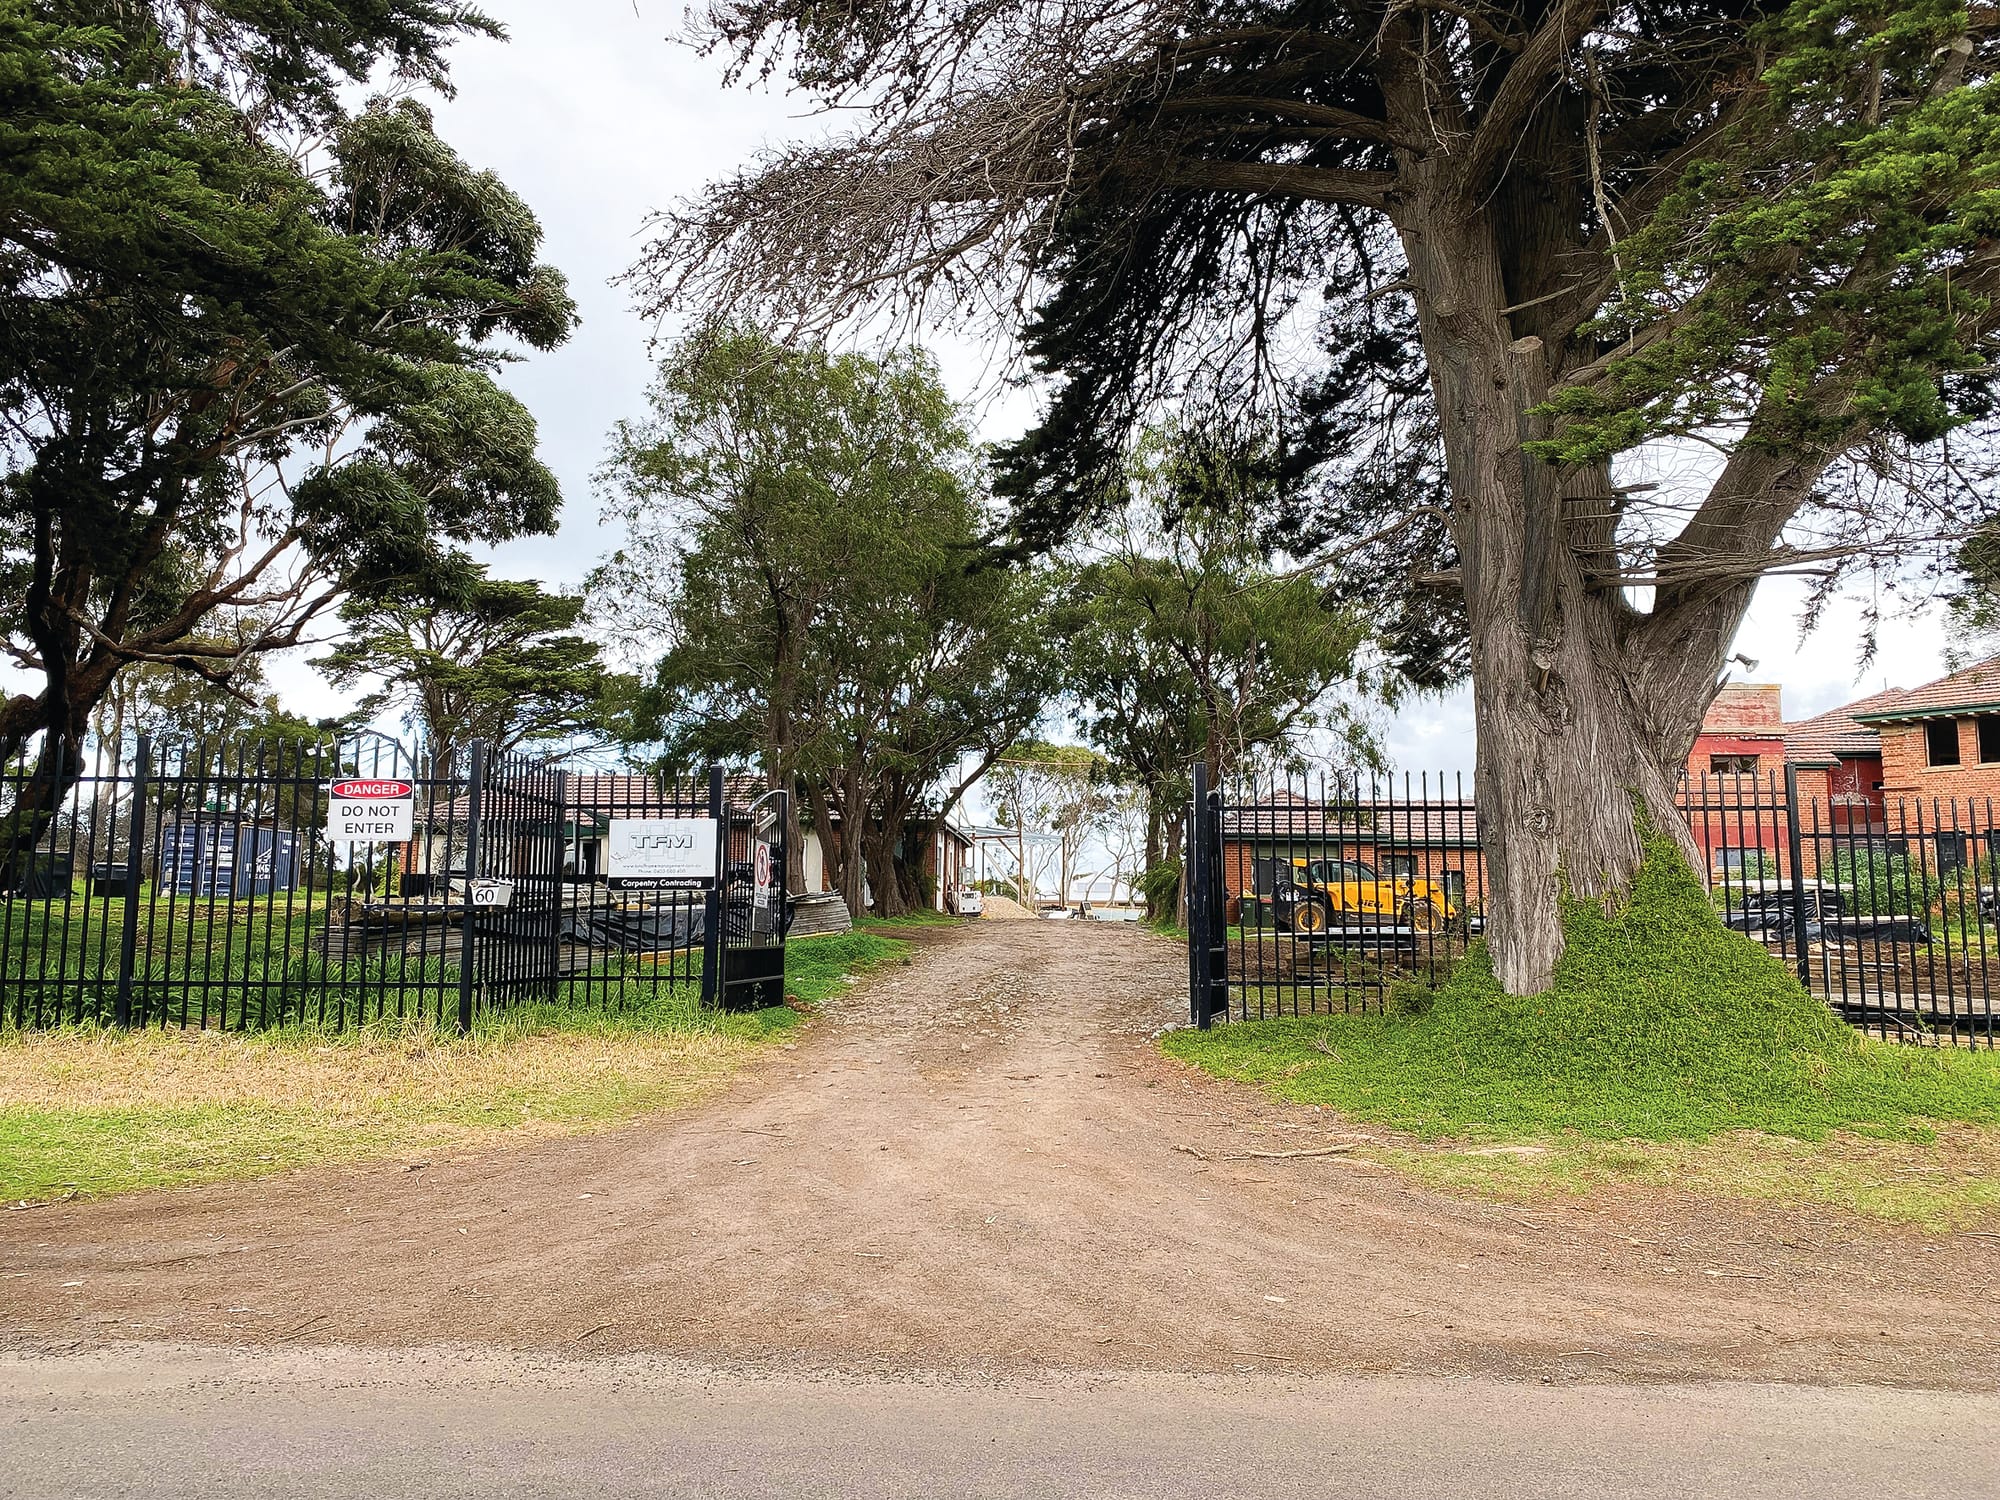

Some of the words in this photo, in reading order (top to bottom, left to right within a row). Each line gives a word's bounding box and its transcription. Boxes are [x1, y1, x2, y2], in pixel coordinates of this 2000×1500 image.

[344, 784, 400, 795] DANGER
[341, 806, 363, 817] DO
[368, 806, 400, 817] NOT
[344, 823, 394, 834] ENTER
[631, 834, 693, 849] TFM
[621, 879, 658, 889] Carpentry
[659, 879, 702, 888] Contracting
[475, 889, 494, 903] 60
